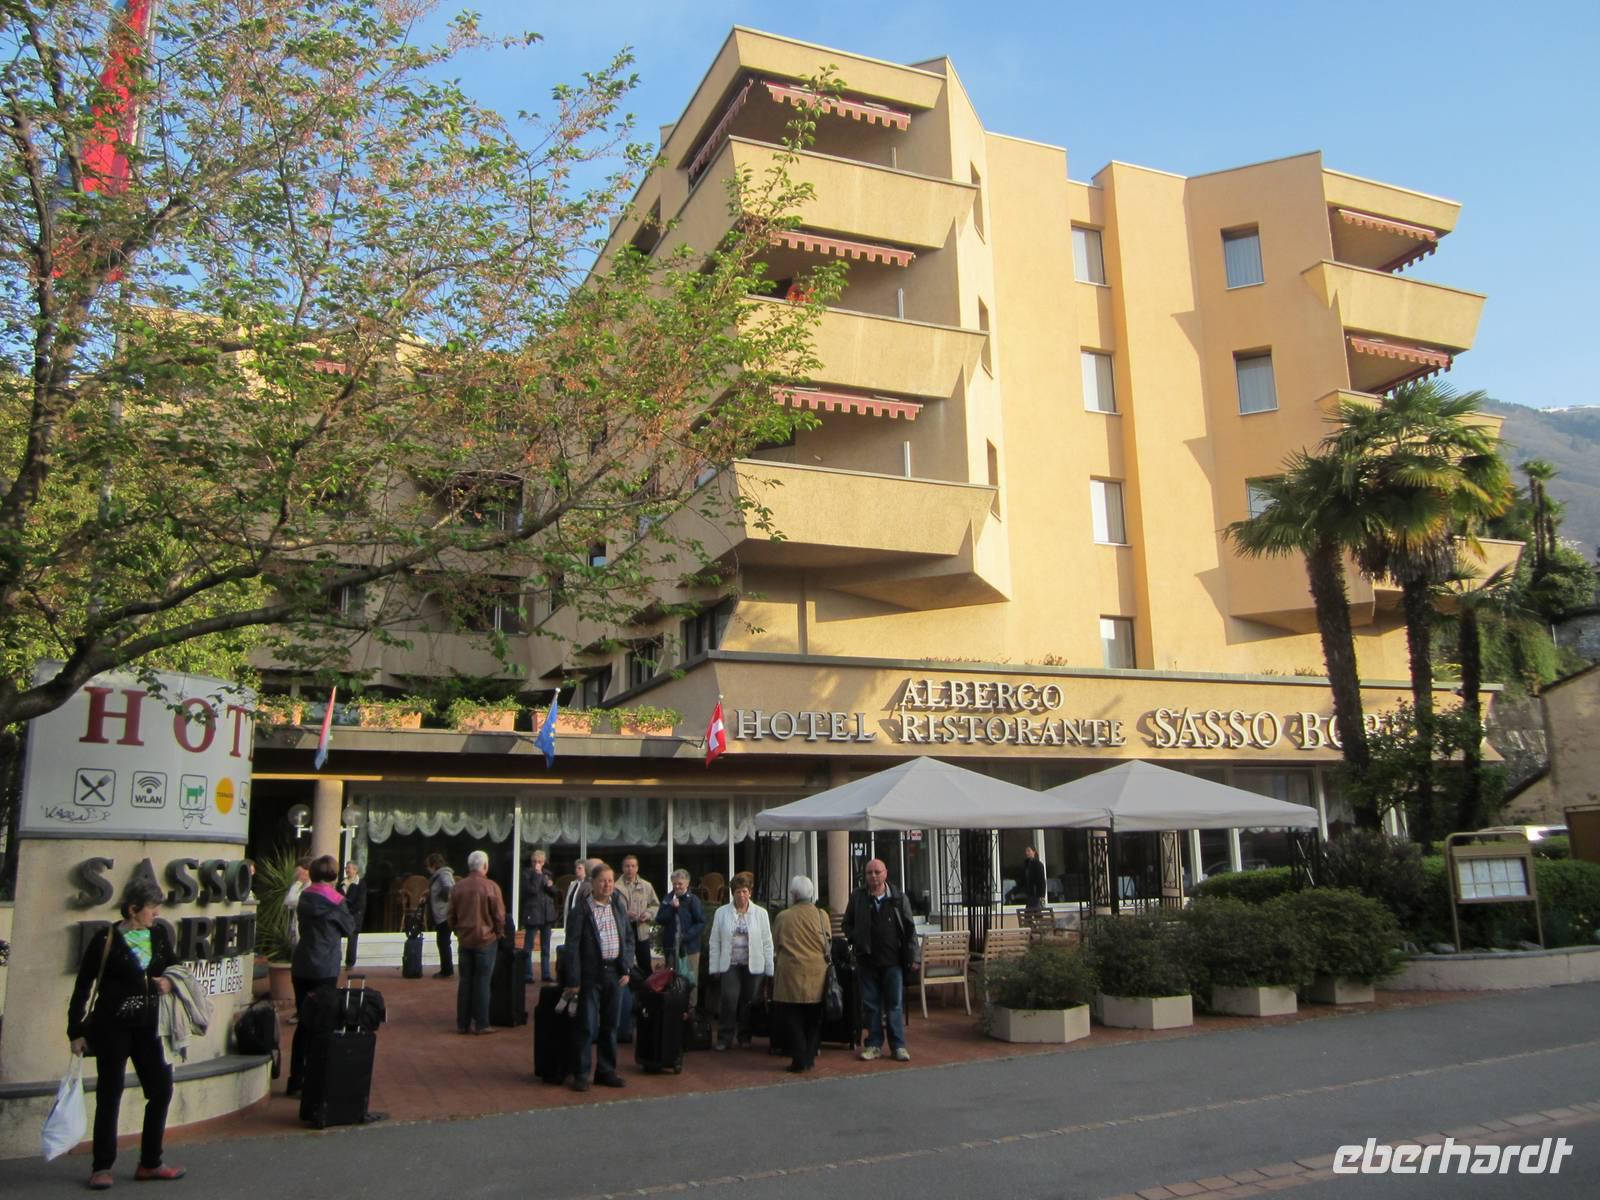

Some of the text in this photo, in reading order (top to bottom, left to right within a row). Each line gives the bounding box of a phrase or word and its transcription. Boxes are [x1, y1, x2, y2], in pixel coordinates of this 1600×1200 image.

[899, 678, 1065, 711] ALBERGO
[79, 686, 254, 762] HOT
[736, 709, 876, 743] HOTEL
[899, 713, 1128, 747] RISTORANTE
[1153, 707, 1283, 749] SASSO
[135, 795, 162, 804] WLAN
